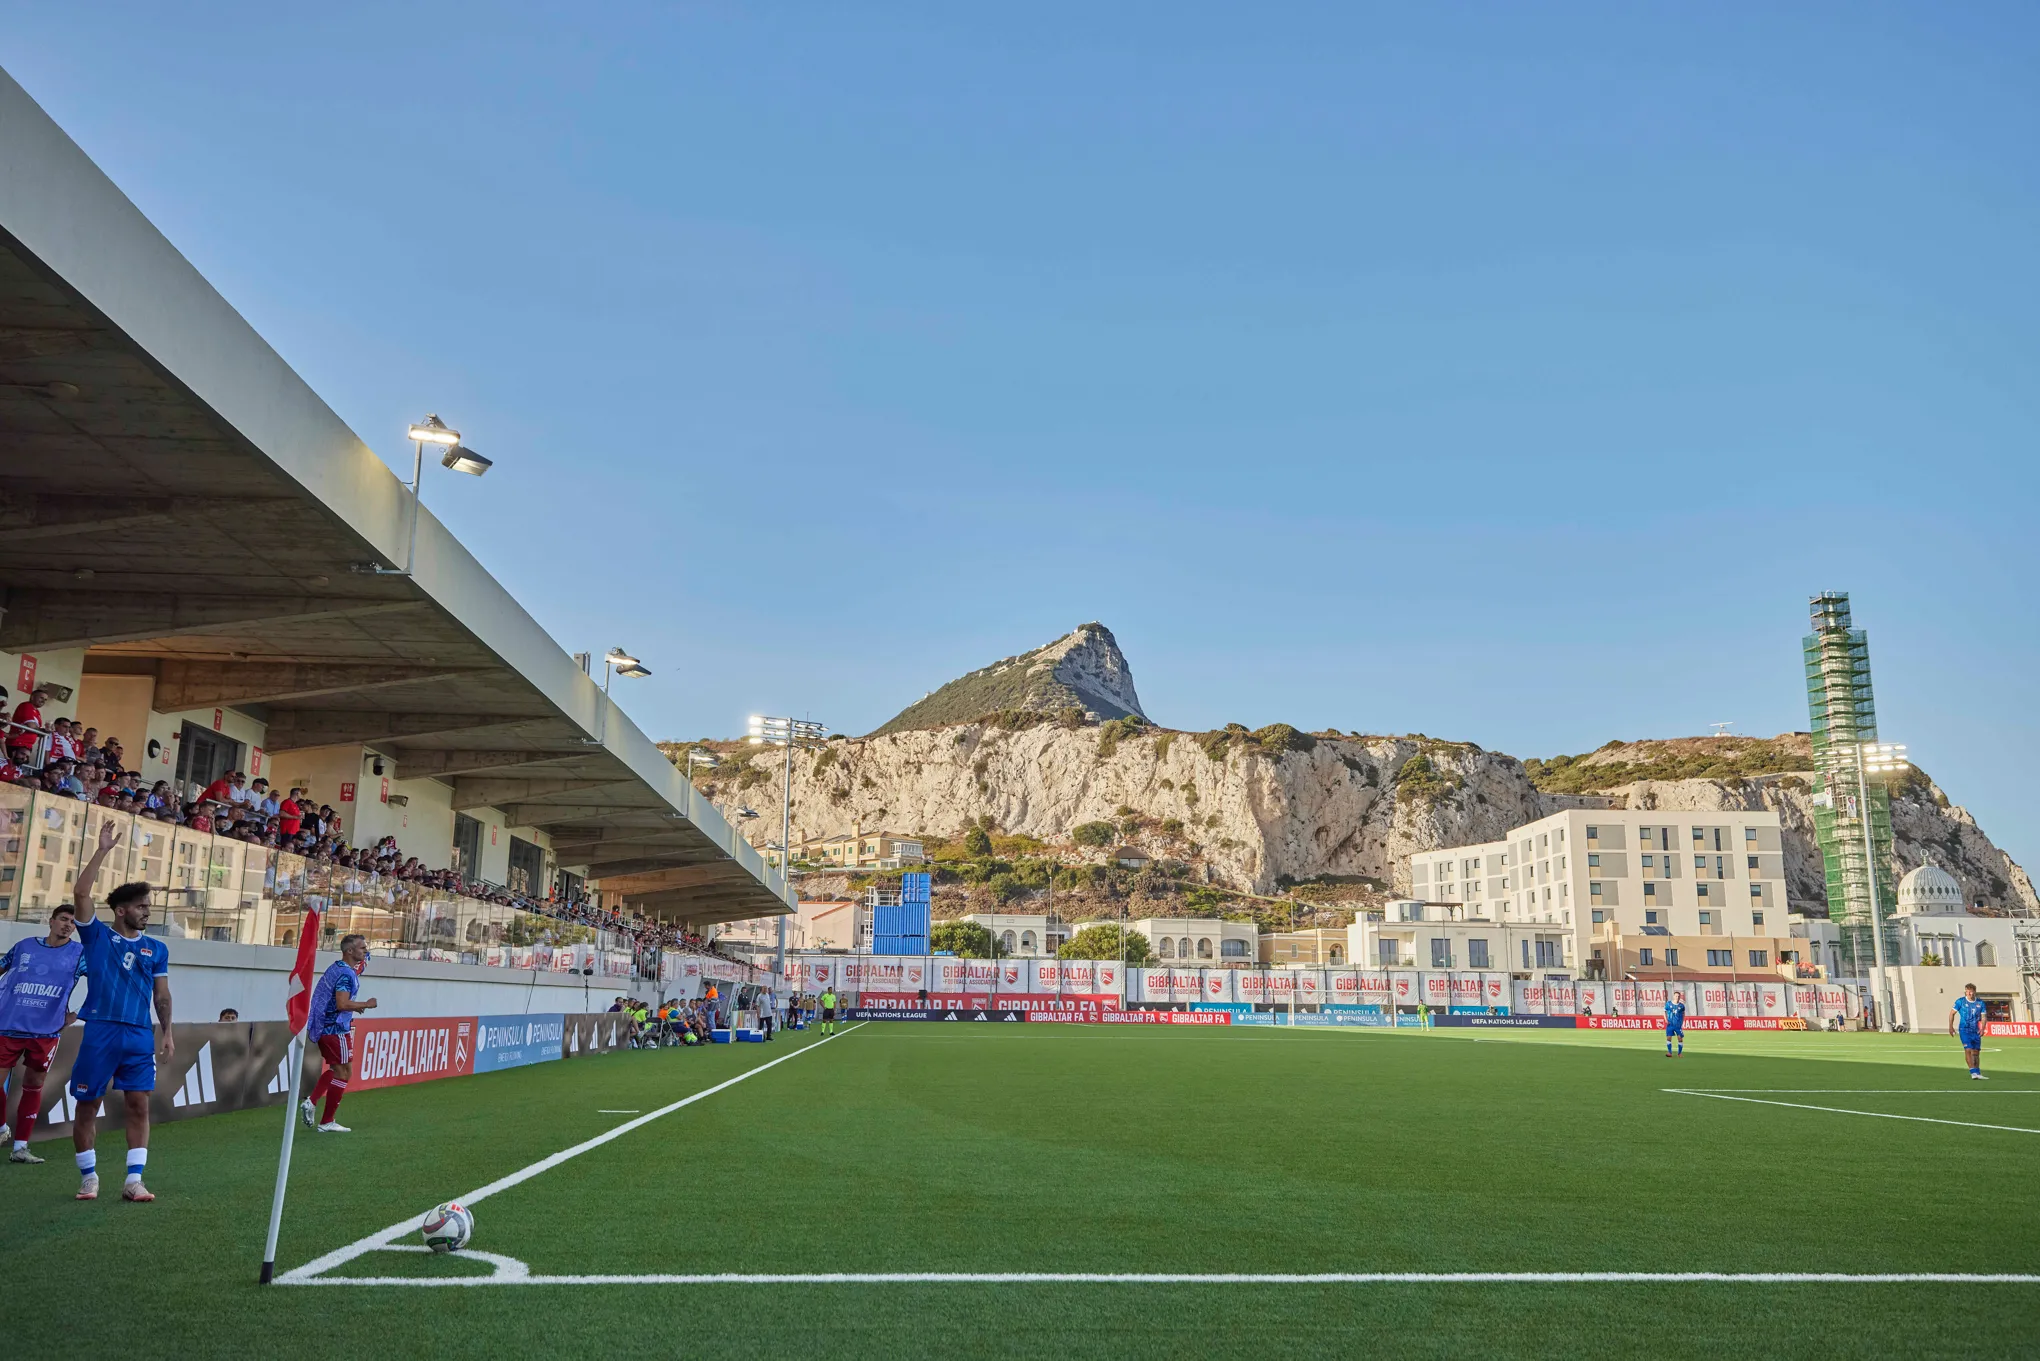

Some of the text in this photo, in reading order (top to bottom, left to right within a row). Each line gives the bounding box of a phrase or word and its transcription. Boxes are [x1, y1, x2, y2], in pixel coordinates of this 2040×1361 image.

[25, 670, 30, 681] C
[122, 951, 136, 971] 9
[845, 965, 904, 978] GIBRALTAR
[943, 966, 1000, 979] GIBRALTAR
[1039, 967, 1096, 980] GIBRALTAR
[1147, 975, 1204, 988] GIBRALTAR
[1242, 977, 1298, 989] GIBRALTAR
[1336, 979, 1391, 991] GIBRALTAR
[1428, 979, 1483, 992] GIBRALTAR
[1523, 988, 1578, 1000] GIBRALTAR
[1614, 989, 1669, 1001] GIBRALTAR
[1705, 990, 1760, 1003] GIBRALTAR
[1030, 1012, 1085, 1022] GIBRALTAR FA
[1102, 1013, 1156, 1023] GIBRALTAR FA
[1171, 1014, 1225, 1024] GIBRALTAR FA
[1601, 1019, 1653, 1029] GIBRALTAR FA
[1709, 1019, 1720, 1029] FA
[1990, 1024, 2040, 1037] GIBRALTAR FA
[486, 1026, 524, 1048] PENINSULA
[532, 1023, 563, 1043] PENINSULA
[47, 1046, 56, 1061] 4
[360, 1029, 436, 1081] GIBRALTAR
